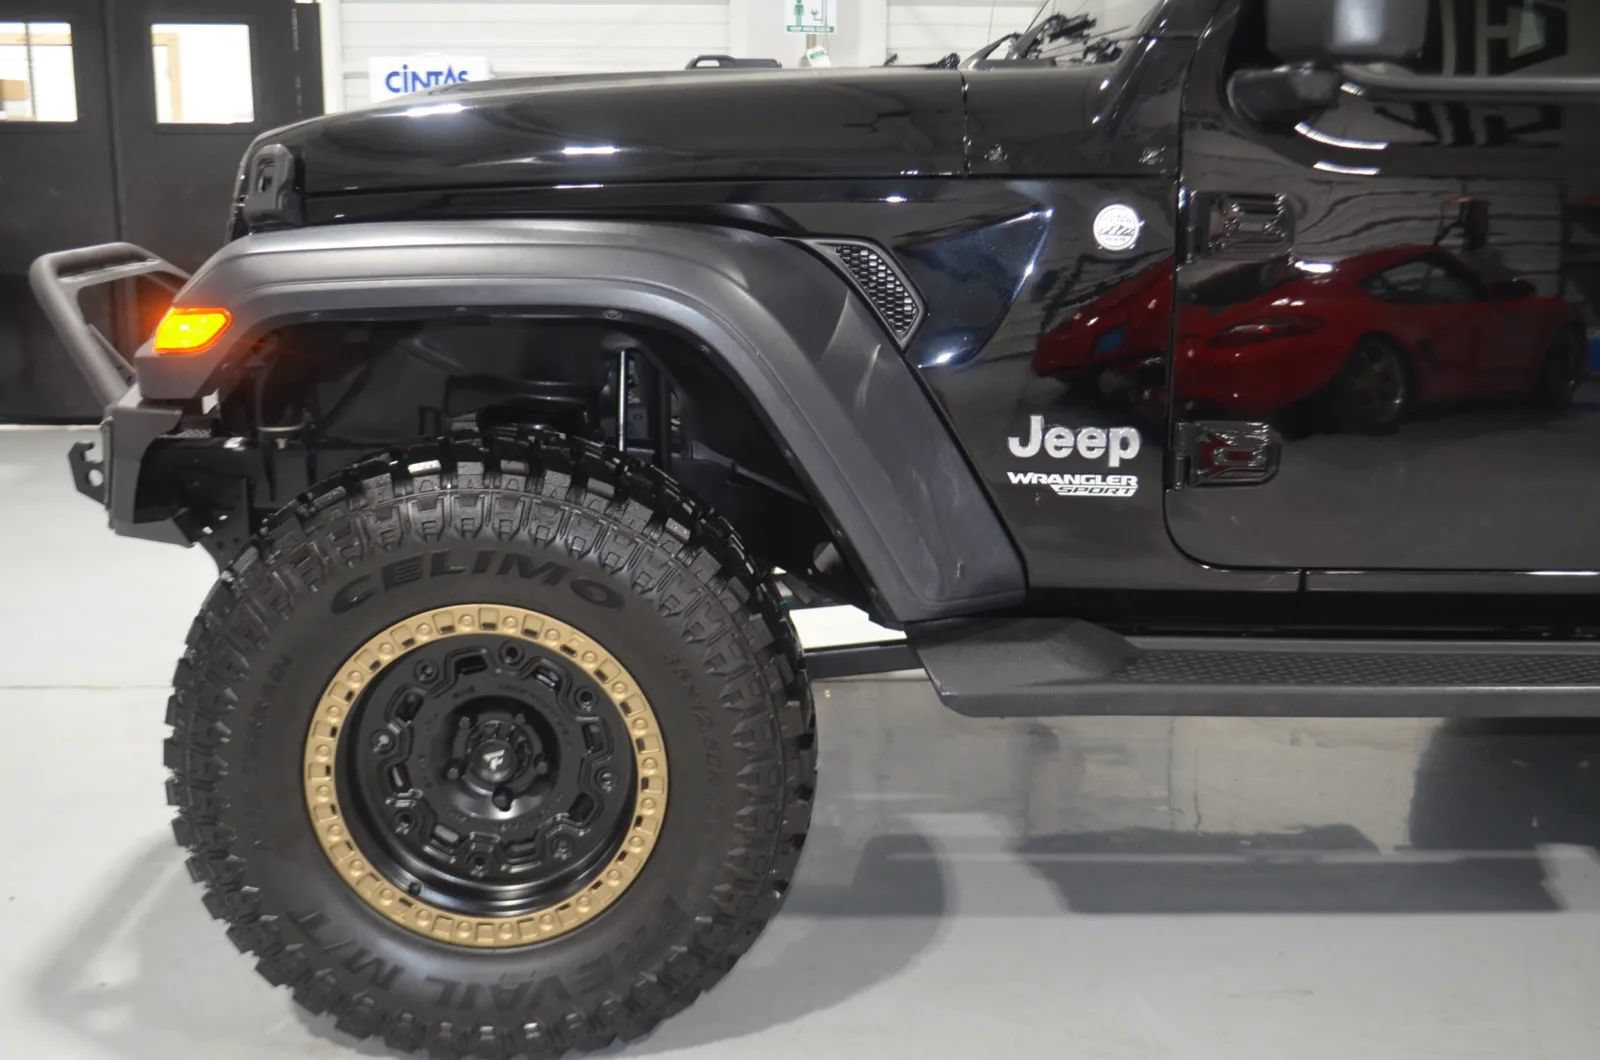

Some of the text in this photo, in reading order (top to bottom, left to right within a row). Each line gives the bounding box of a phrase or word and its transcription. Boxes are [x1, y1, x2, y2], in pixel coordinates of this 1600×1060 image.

[1007, 414, 1141, 467] Jeep
[1007, 471, 1138, 485] WRANGLER
[1054, 485, 1136, 496] SPORT
[331, 549, 624, 613] CELIMO
